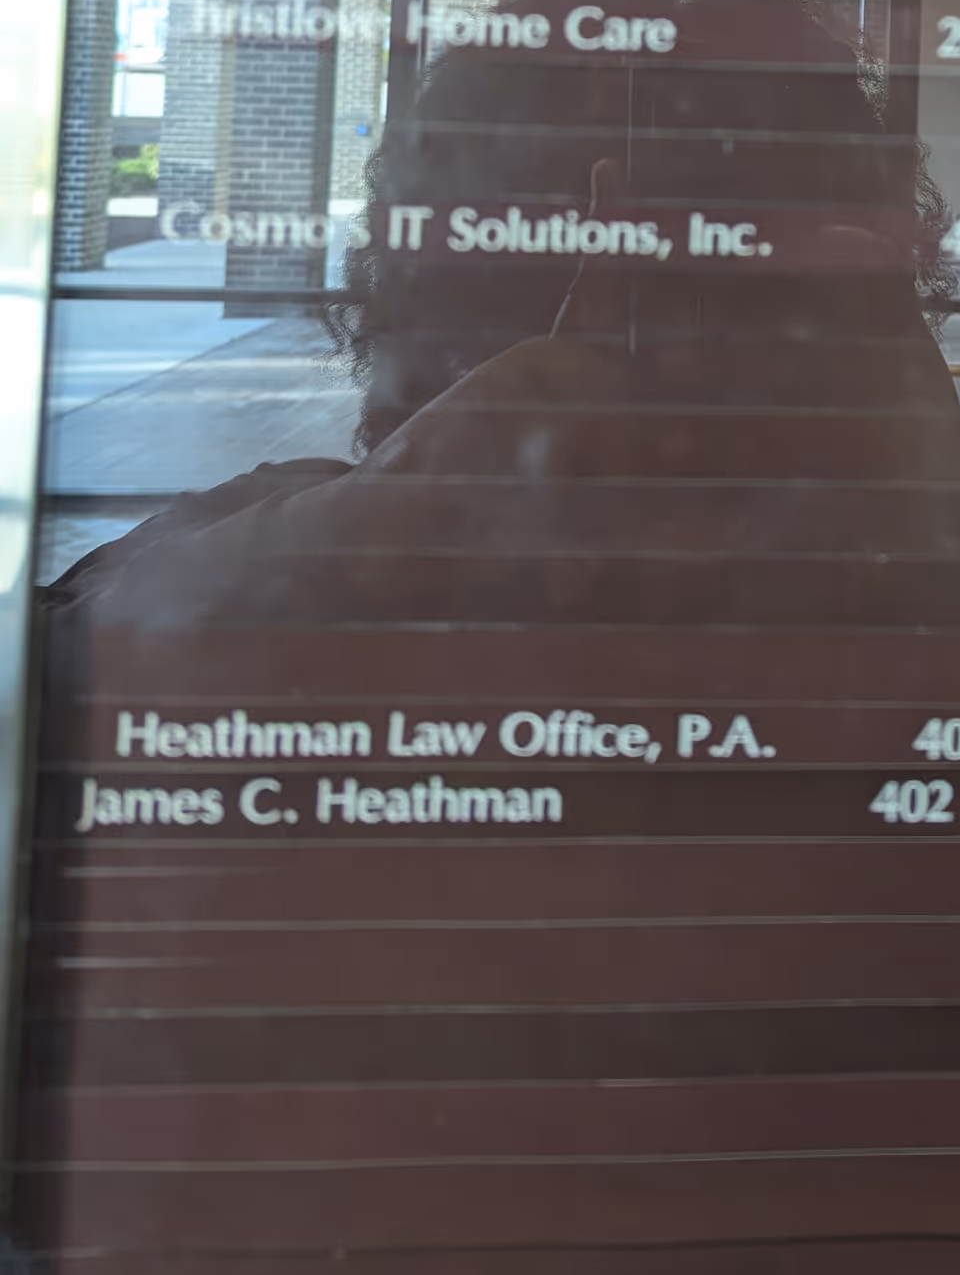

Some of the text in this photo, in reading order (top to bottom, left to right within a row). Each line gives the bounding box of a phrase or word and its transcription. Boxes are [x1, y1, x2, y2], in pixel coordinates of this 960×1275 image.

[406, 0, 550, 51] Home
[564, 5, 676, 55] Care
[388, 205, 434, 251] IT
[448, 208, 673, 261] Solutions,
[688, 211, 772, 259] Inc.
[115, 711, 372, 760] Heathman
[389, 711, 485, 758] Law
[499, 711, 662, 765] Office,
[677, 714, 777, 760] P.A.
[76, 777, 955, 832] James C. Heathman 402
